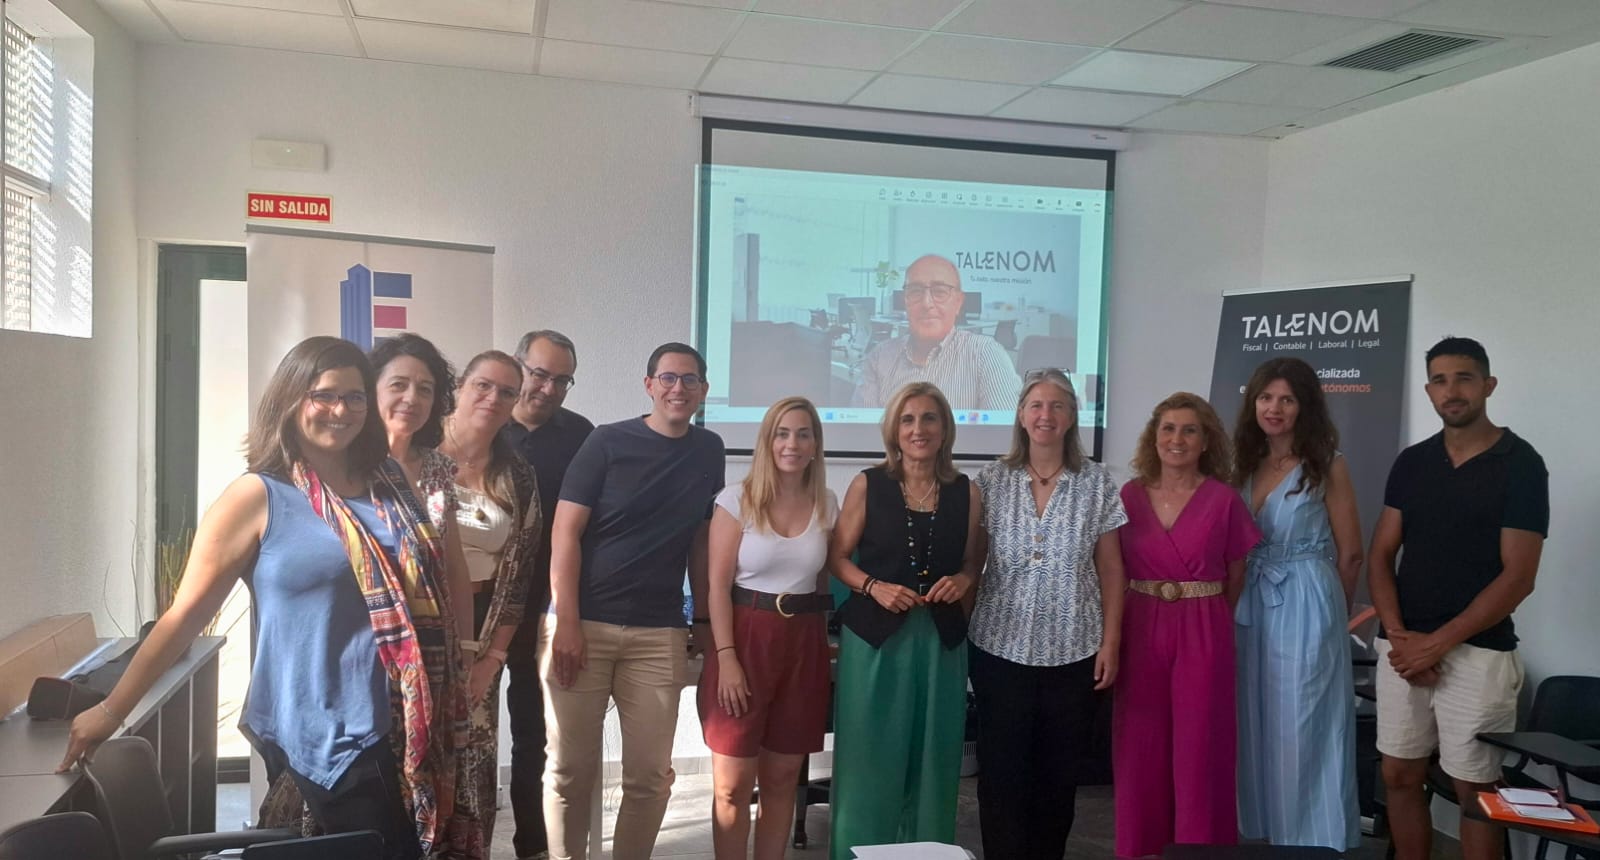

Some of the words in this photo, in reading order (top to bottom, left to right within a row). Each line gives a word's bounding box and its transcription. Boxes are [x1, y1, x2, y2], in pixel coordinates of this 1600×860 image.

[250, 199, 274, 213] SIN
[279, 200, 328, 216] SALIDA
[955, 250, 1056, 273] TALENOM
[1242, 308, 1380, 339] TALENOM
[1242, 343, 1262, 352] Fiscal
[1273, 342, 1307, 351] Contable
[1318, 340, 1347, 349] Laboral
[1358, 339, 1380, 349] Legal
[1316, 368, 1361, 379] cializada
[1321, 383, 1371, 393] tónomos
